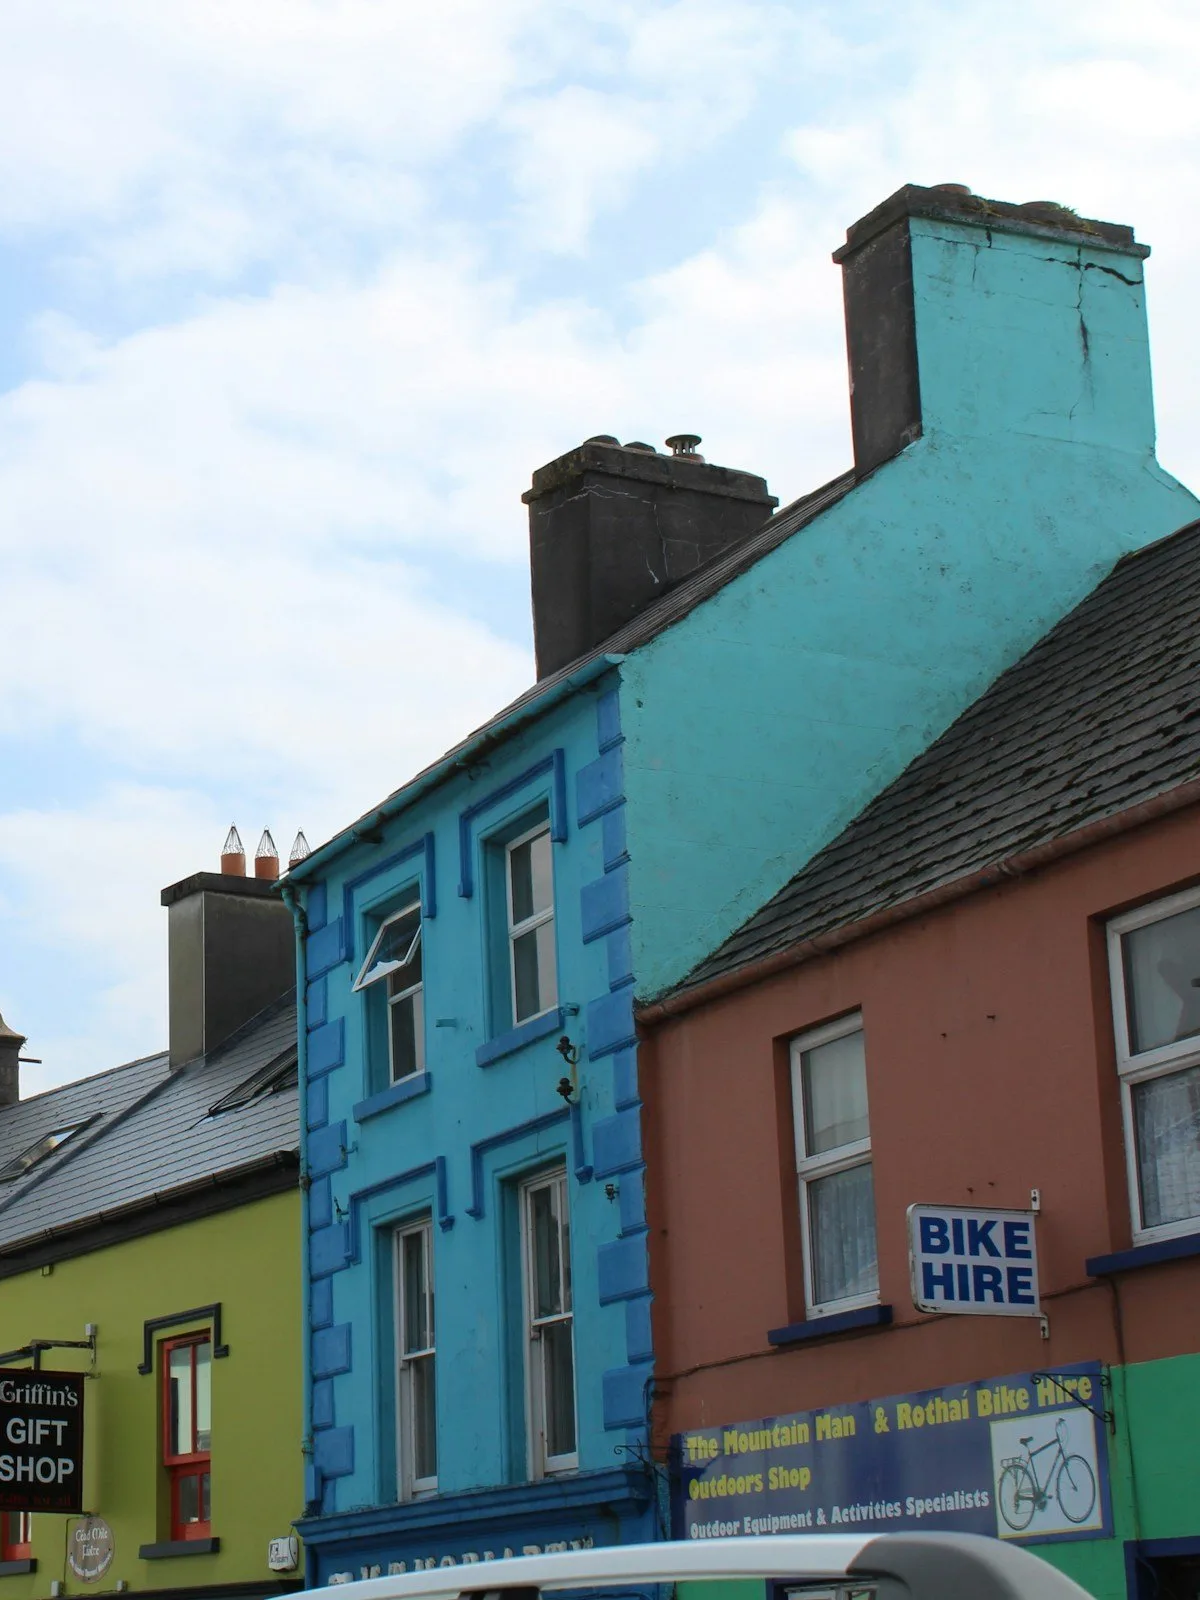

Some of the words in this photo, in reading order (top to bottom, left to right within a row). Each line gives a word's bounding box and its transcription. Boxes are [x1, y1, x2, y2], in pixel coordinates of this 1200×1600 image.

[919, 1216, 1032, 1259] BIKE
[921, 1262, 1035, 1305] HIRE
[6, 1417, 68, 1446] GIFT
[687, 1435, 718, 1461] The
[723, 1419, 810, 1456] Mountain
[815, 1413, 856, 1441] Man
[874, 1406, 890, 1434] &
[896, 1390, 969, 1431] Rothaí
[976, 1384, 1030, 1418] Bike
[1037, 1375, 1093, 1408] Hire
[688, 1472, 763, 1500] Outdoors
[768, 1465, 812, 1491] Shop
[690, 1519, 741, 1540] Outdoor
[743, 1509, 813, 1536] Equipment
[816, 1507, 828, 1526] &
[831, 1498, 902, 1525] Activities
[906, 1488, 990, 1519] Specialists
